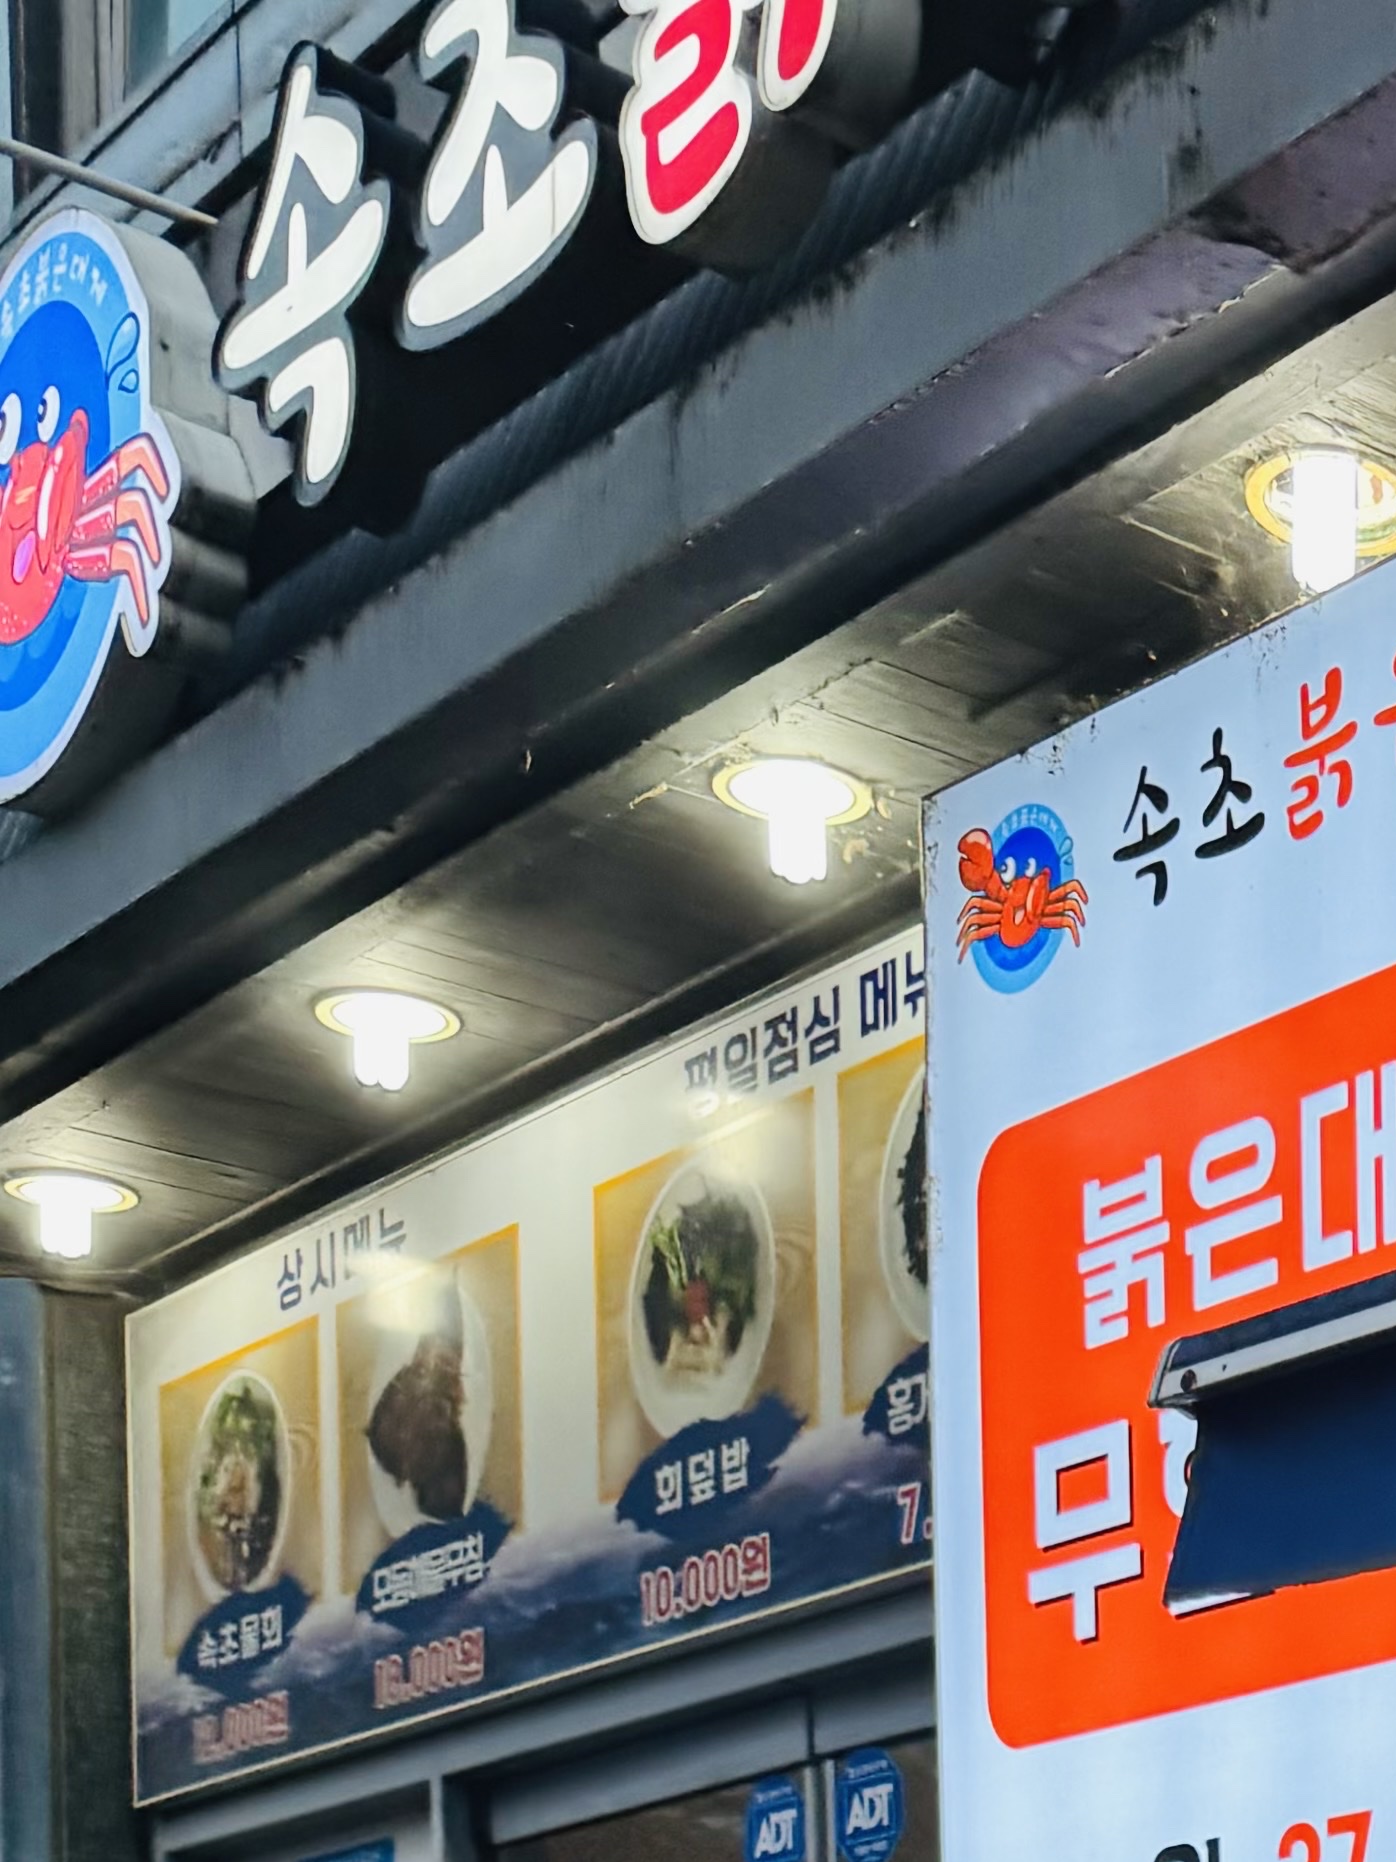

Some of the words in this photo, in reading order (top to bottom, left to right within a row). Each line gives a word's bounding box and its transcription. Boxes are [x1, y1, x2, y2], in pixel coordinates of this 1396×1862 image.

[685, 985, 841, 1118] 평일점심
[655, 1437, 750, 1515] 회덮밥
[640, 1532, 771, 1627] 10.000원
[754, 1809, 798, 1859] ADT
[846, 1783, 894, 1835] ADT
